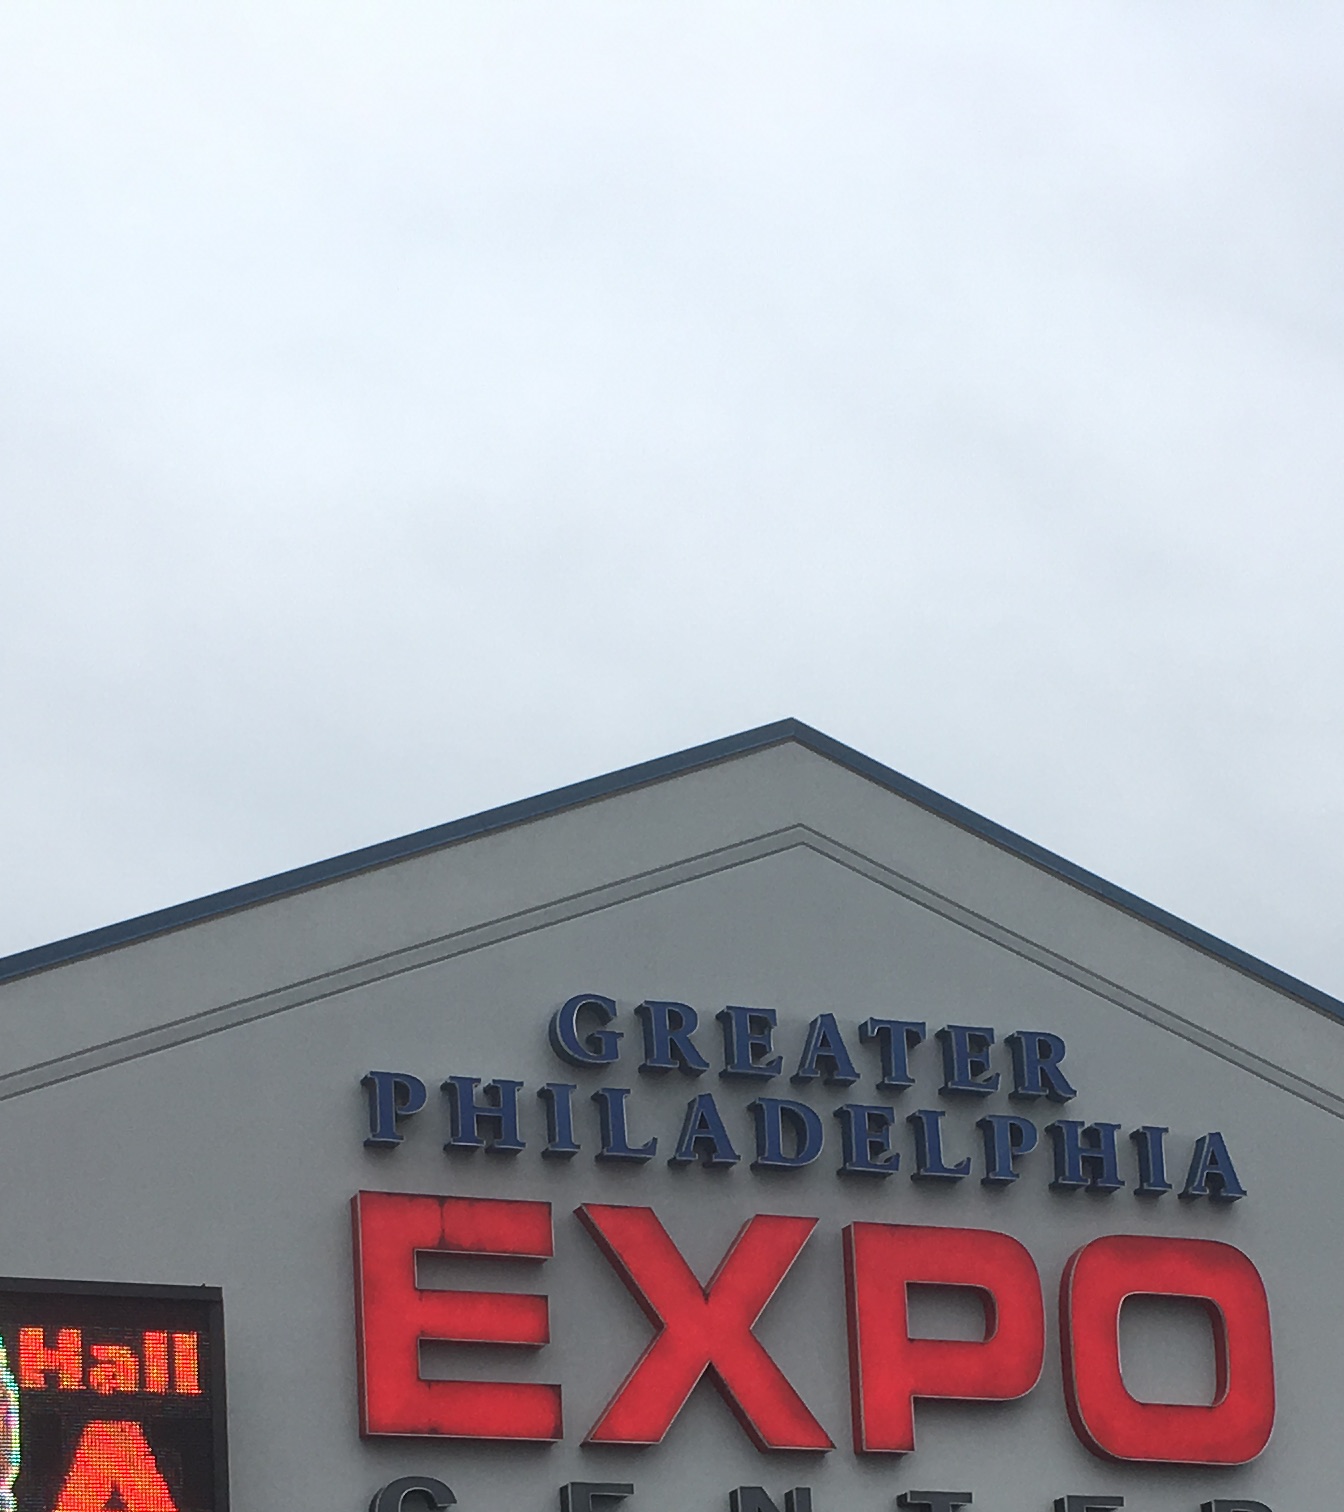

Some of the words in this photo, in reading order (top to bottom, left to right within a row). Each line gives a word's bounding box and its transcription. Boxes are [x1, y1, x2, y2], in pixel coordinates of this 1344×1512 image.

[549, 994, 1077, 1103] GREATER
[360, 1070, 1247, 1201] PHILADELPHIA
[17, 1327, 202, 1396] Hall
[351, 1190, 1276, 1467] EXPO
